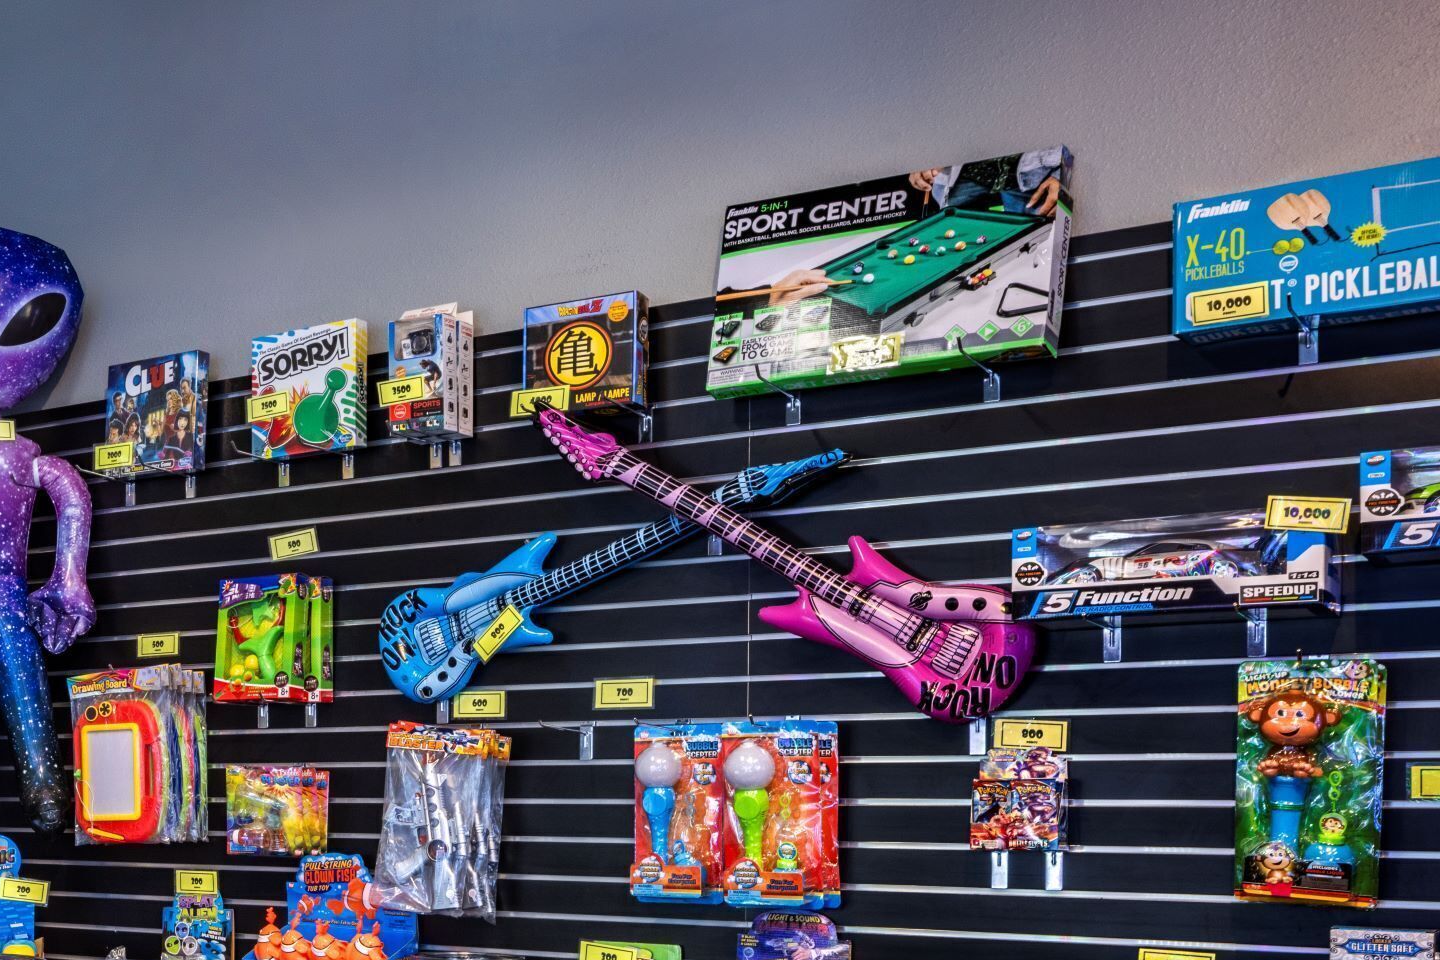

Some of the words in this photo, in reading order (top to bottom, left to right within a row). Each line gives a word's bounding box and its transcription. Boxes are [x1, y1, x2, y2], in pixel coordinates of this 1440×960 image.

[724, 208, 803, 239] SPORT
[809, 191, 908, 224] CENTER
[727, 204, 758, 220] Franklin
[761, 200, 788, 213] 5-IN-1
[1187, 199, 1250, 223] Franklin
[1186, 228, 1245, 268] X-40
[1185, 261, 1244, 282] PICKLEBALLS
[1207, 296, 1251, 312] 10,000
[259, 331, 349, 382] SORRY!
[553, 331, 606, 374] 亀
[125, 360, 178, 394] CLUE
[392, 385, 411, 396] 3500
[575, 391, 598, 404] LAMP
[605, 387, 630, 400] LAMPE
[1289, 571, 1319, 580] 1:14
[1043, 591, 1073, 613] 5
[1076, 585, 1193, 606] Function
[1243, 585, 1317, 599] SPEEDUP
[72, 681, 104, 694] Drawing
[105, 679, 127, 689] Board
[617, 688, 633, 697] 700
[472, 699, 487, 708] 600
[304, 860, 352, 871] PULL-STRING
[305, 870, 333, 884] CLOWN
[337, 868, 357, 882] FISH
[1351, 942, 1389, 953] GLITTER
[1391, 943, 1415, 954] SAFE
